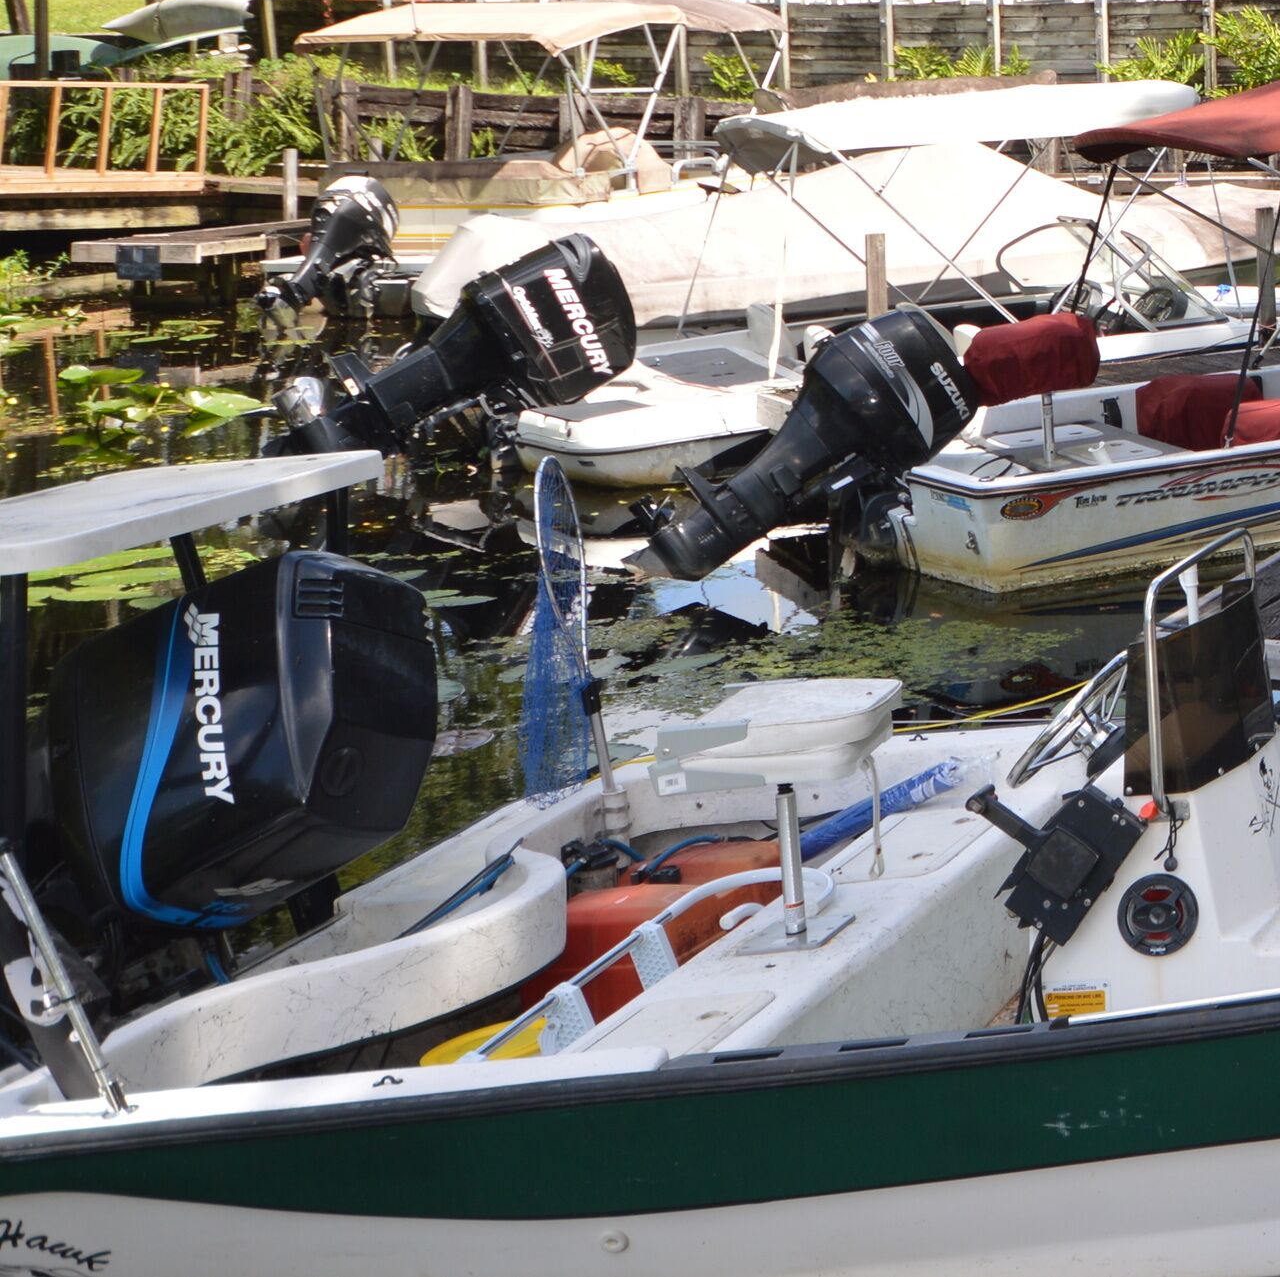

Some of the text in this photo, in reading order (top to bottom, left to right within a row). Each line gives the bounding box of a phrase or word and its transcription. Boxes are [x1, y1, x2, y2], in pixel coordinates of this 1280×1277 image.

[543, 268, 614, 375] MERCURY
[930, 362, 970, 421] SUZUKI
[194, 613, 235, 805] MERCURY
